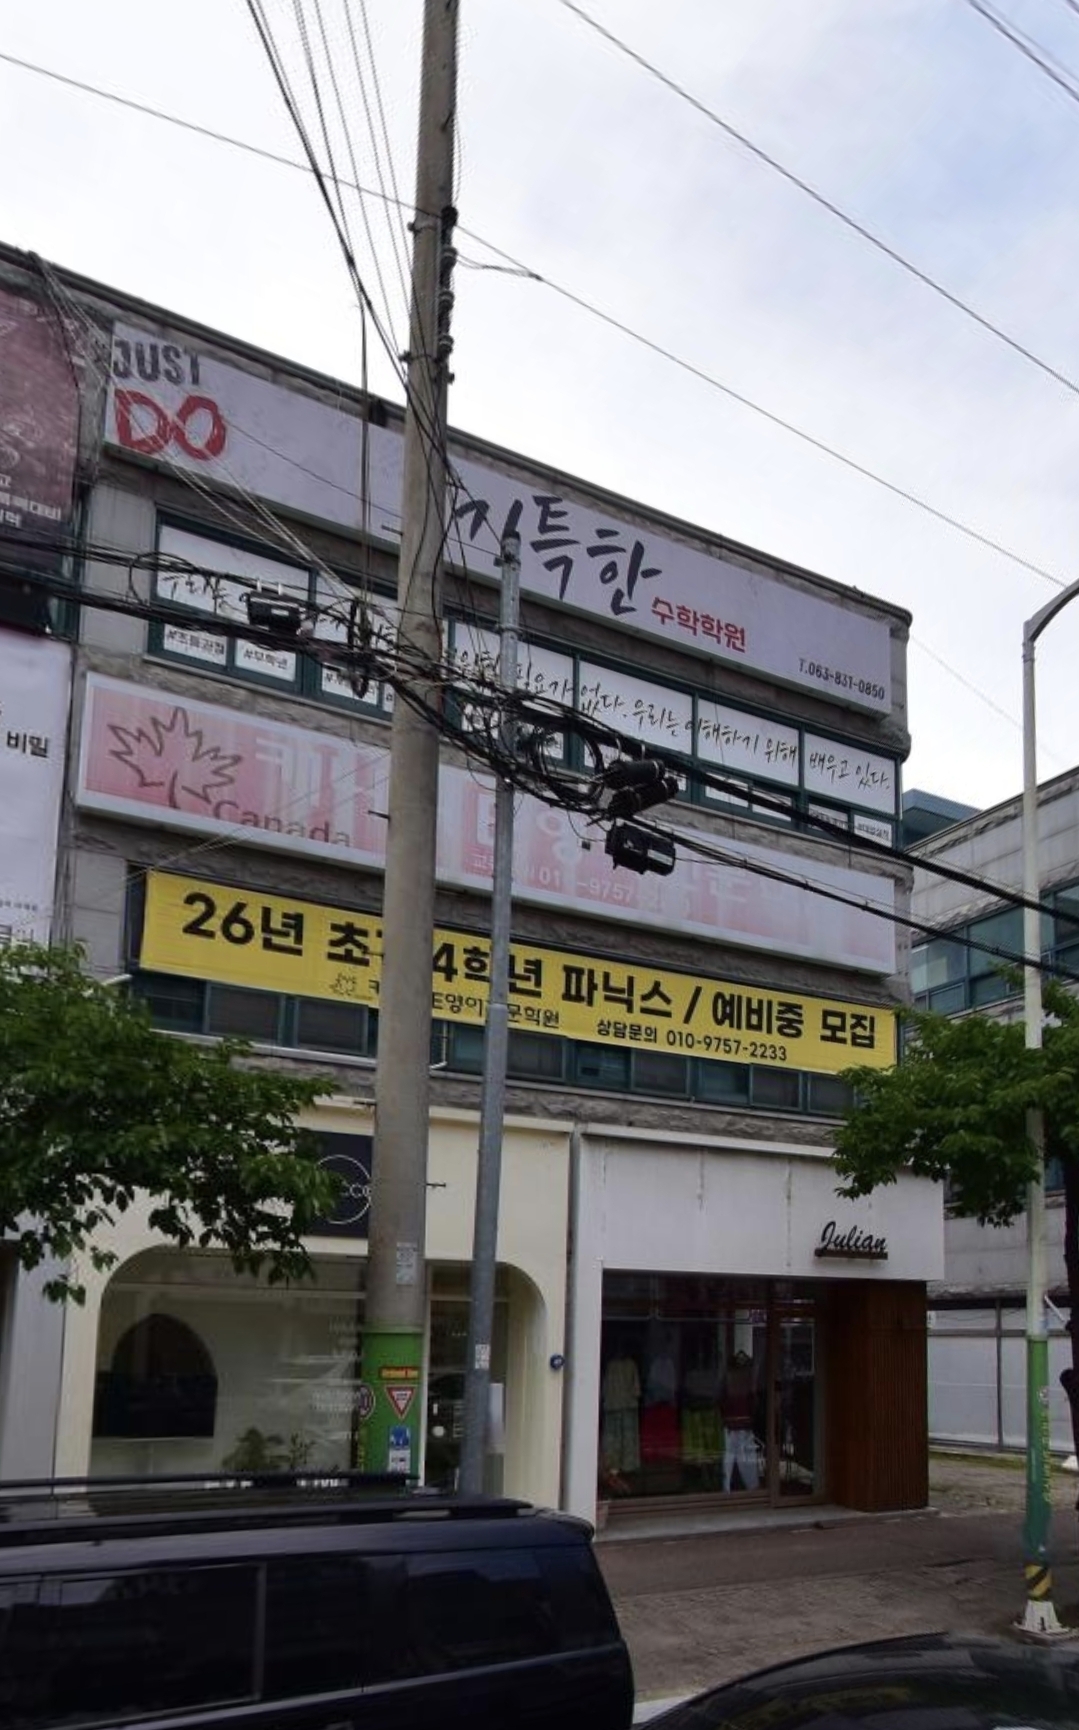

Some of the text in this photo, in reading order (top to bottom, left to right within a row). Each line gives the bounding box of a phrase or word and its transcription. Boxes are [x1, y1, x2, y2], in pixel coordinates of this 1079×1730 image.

[113, 338, 201, 386] JUST
[113, 389, 227, 461] DO
[651, 597, 746, 653] 수학학원
[798, 657, 886, 700] T.063-831-0850
[6, 730, 49, 758] 비밀
[632, 698, 680, 737] 우리는
[684, 715, 760, 753] 이해하기
[764, 737, 798, 768] 위해
[809, 751, 850, 784] 배우고
[213, 800, 352, 848] Canada
[182, 891, 304, 957] 26년
[561, 963, 674, 1018] 파닉스
[712, 991, 805, 1039] 예비중
[820, 1009, 877, 1049] 모집
[597, 1017, 658, 1044] 상담문의
[666, 1029, 788, 1062] 010-9757-2233
[820, 1220, 887, 1253] Julian
